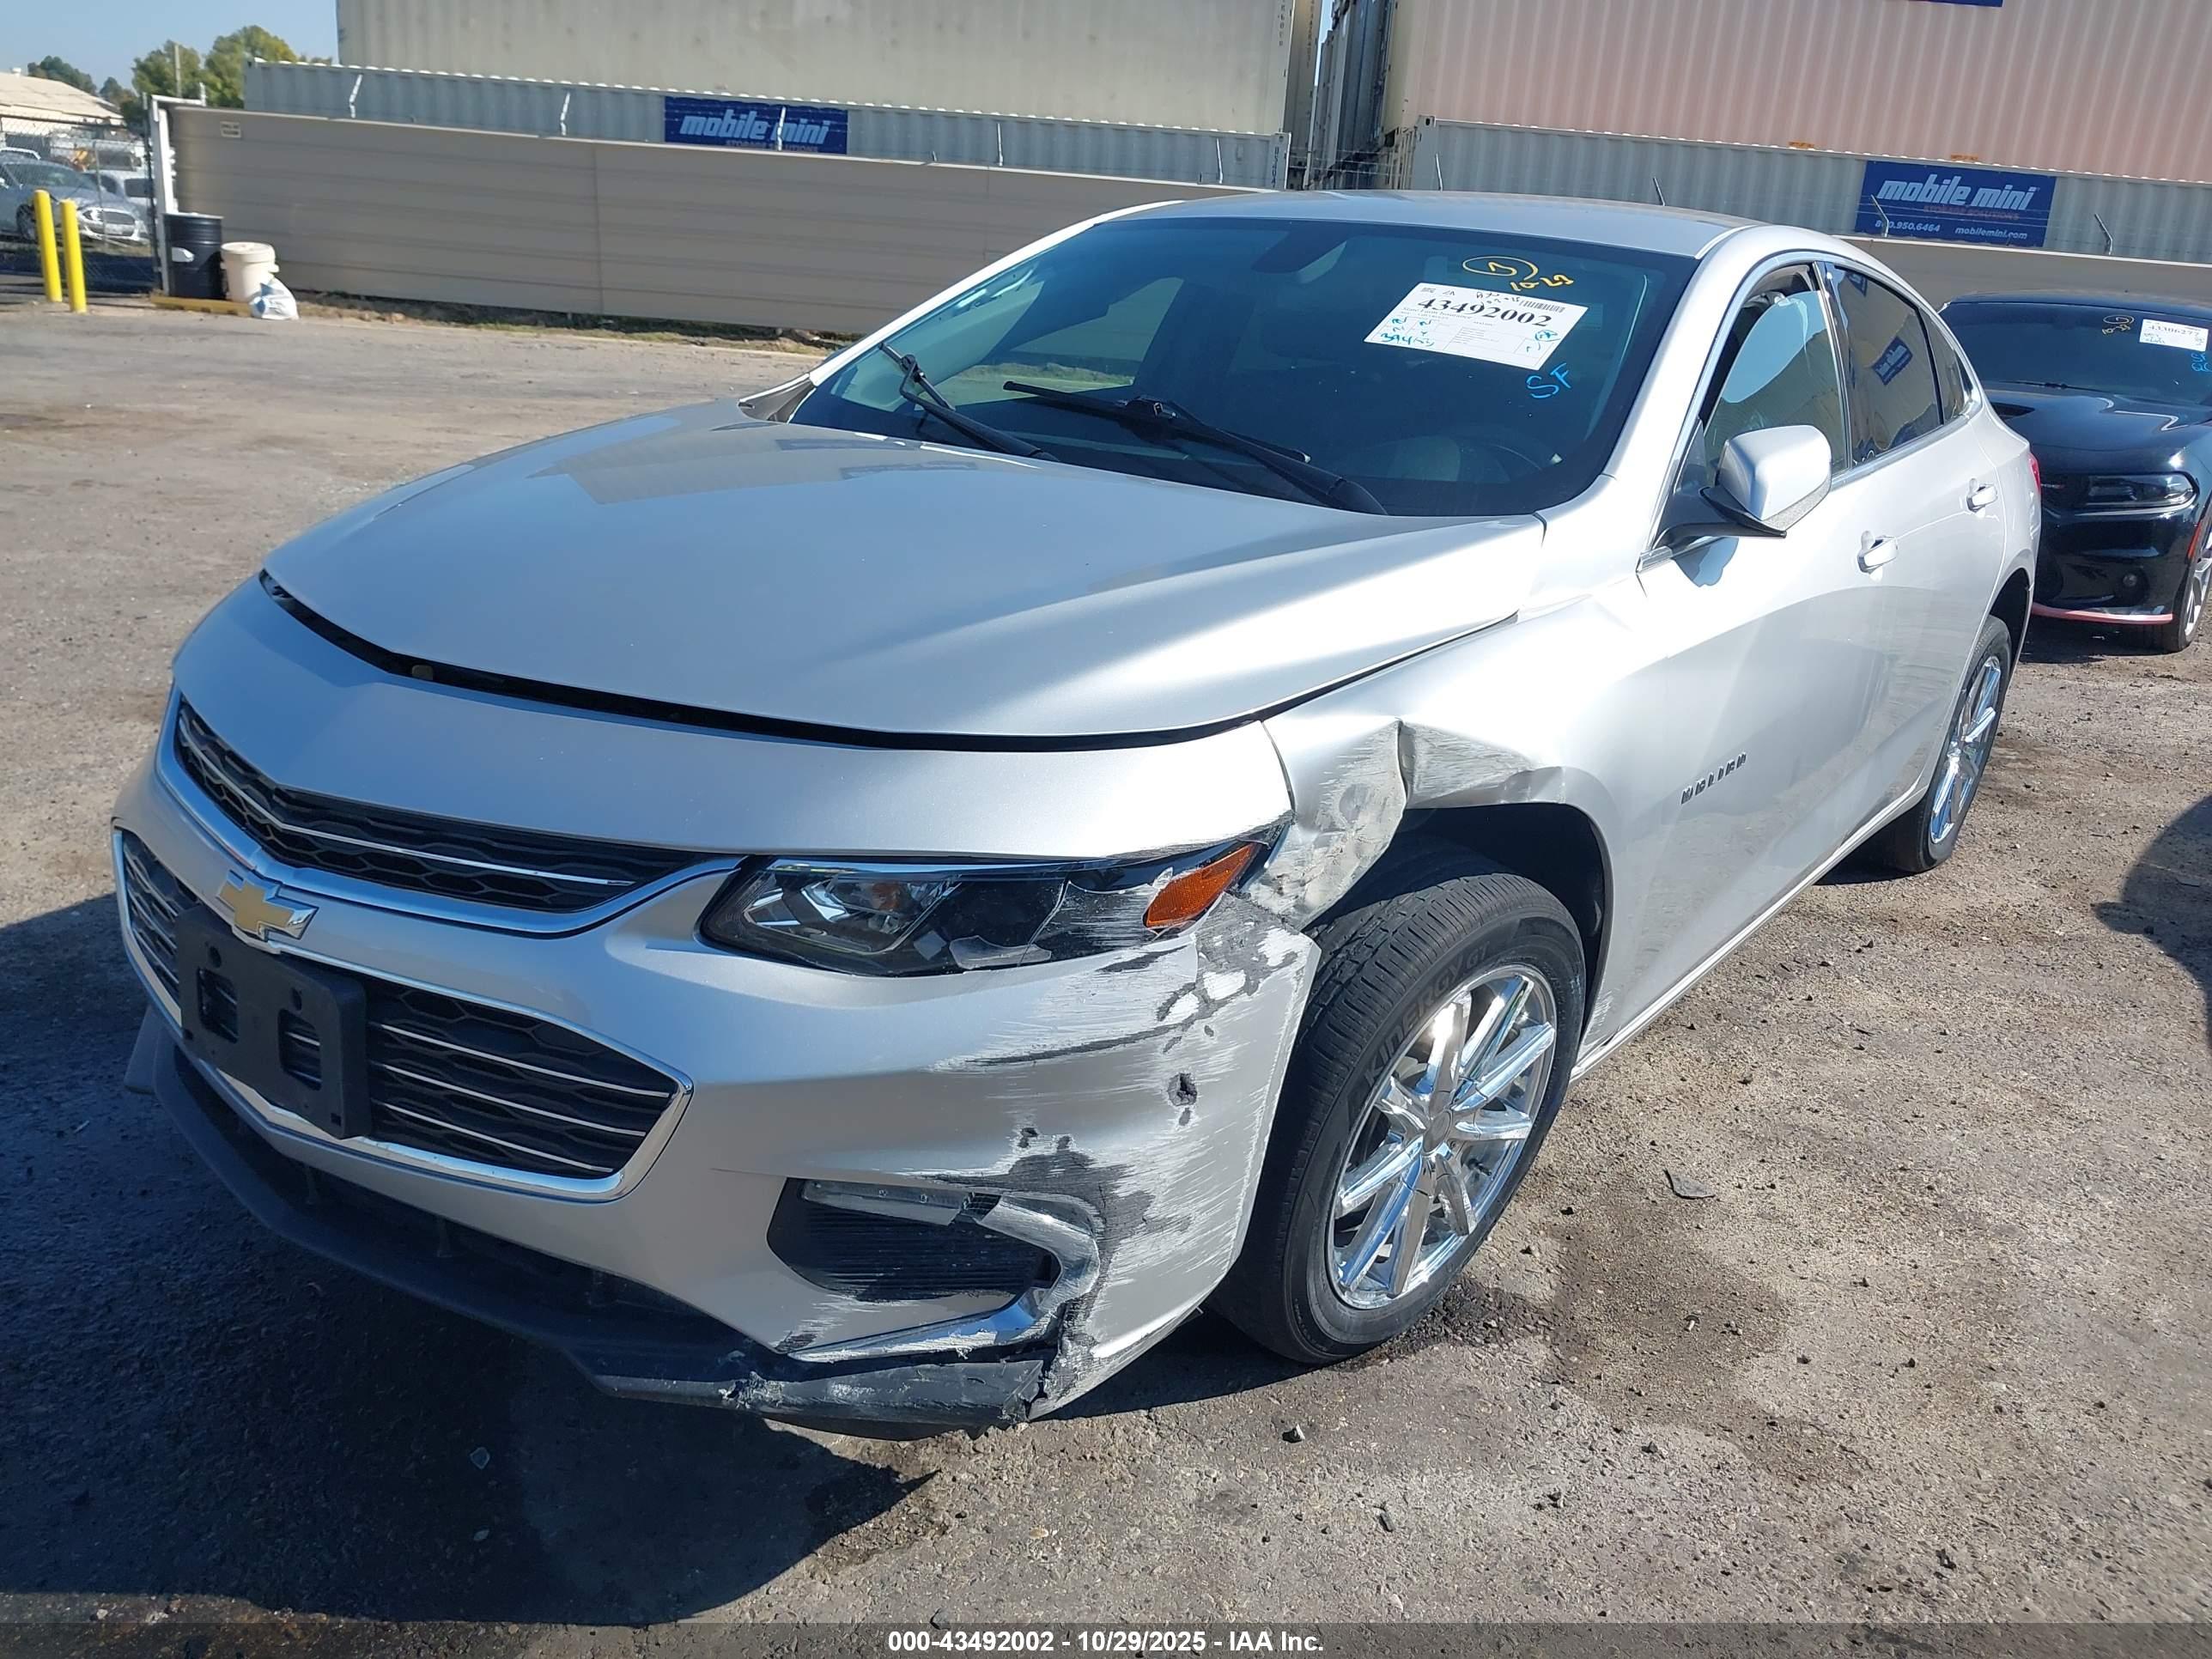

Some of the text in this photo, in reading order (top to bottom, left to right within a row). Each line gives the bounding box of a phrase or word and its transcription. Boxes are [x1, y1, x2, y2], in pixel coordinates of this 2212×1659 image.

[680, 109, 831, 144] mobile mini
[1877, 173, 2036, 210] mobile mini
[1875, 220, 1941, 232] 80.950.6464
[1954, 226, 2027, 240] mobilemini.com
[1417, 298, 1553, 327] 43492002
[1525, 362, 1571, 398] SF
